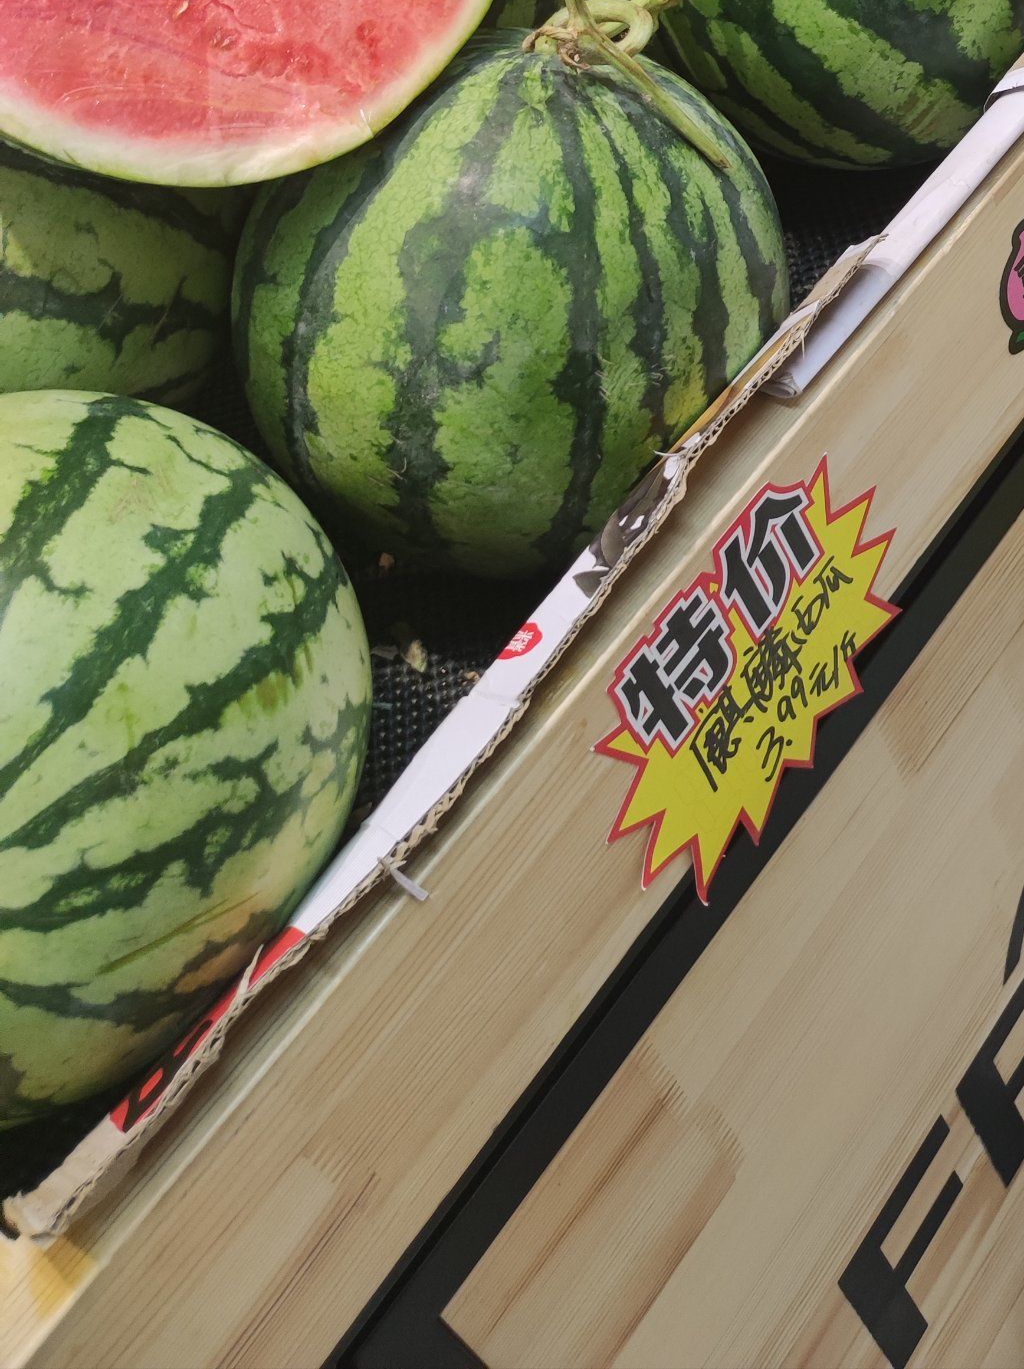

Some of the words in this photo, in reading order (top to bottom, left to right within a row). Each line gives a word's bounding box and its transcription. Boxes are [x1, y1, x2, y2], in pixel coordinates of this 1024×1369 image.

[619, 490, 818, 745] 特价
[690, 554, 854, 793] 麒麟西瓜
